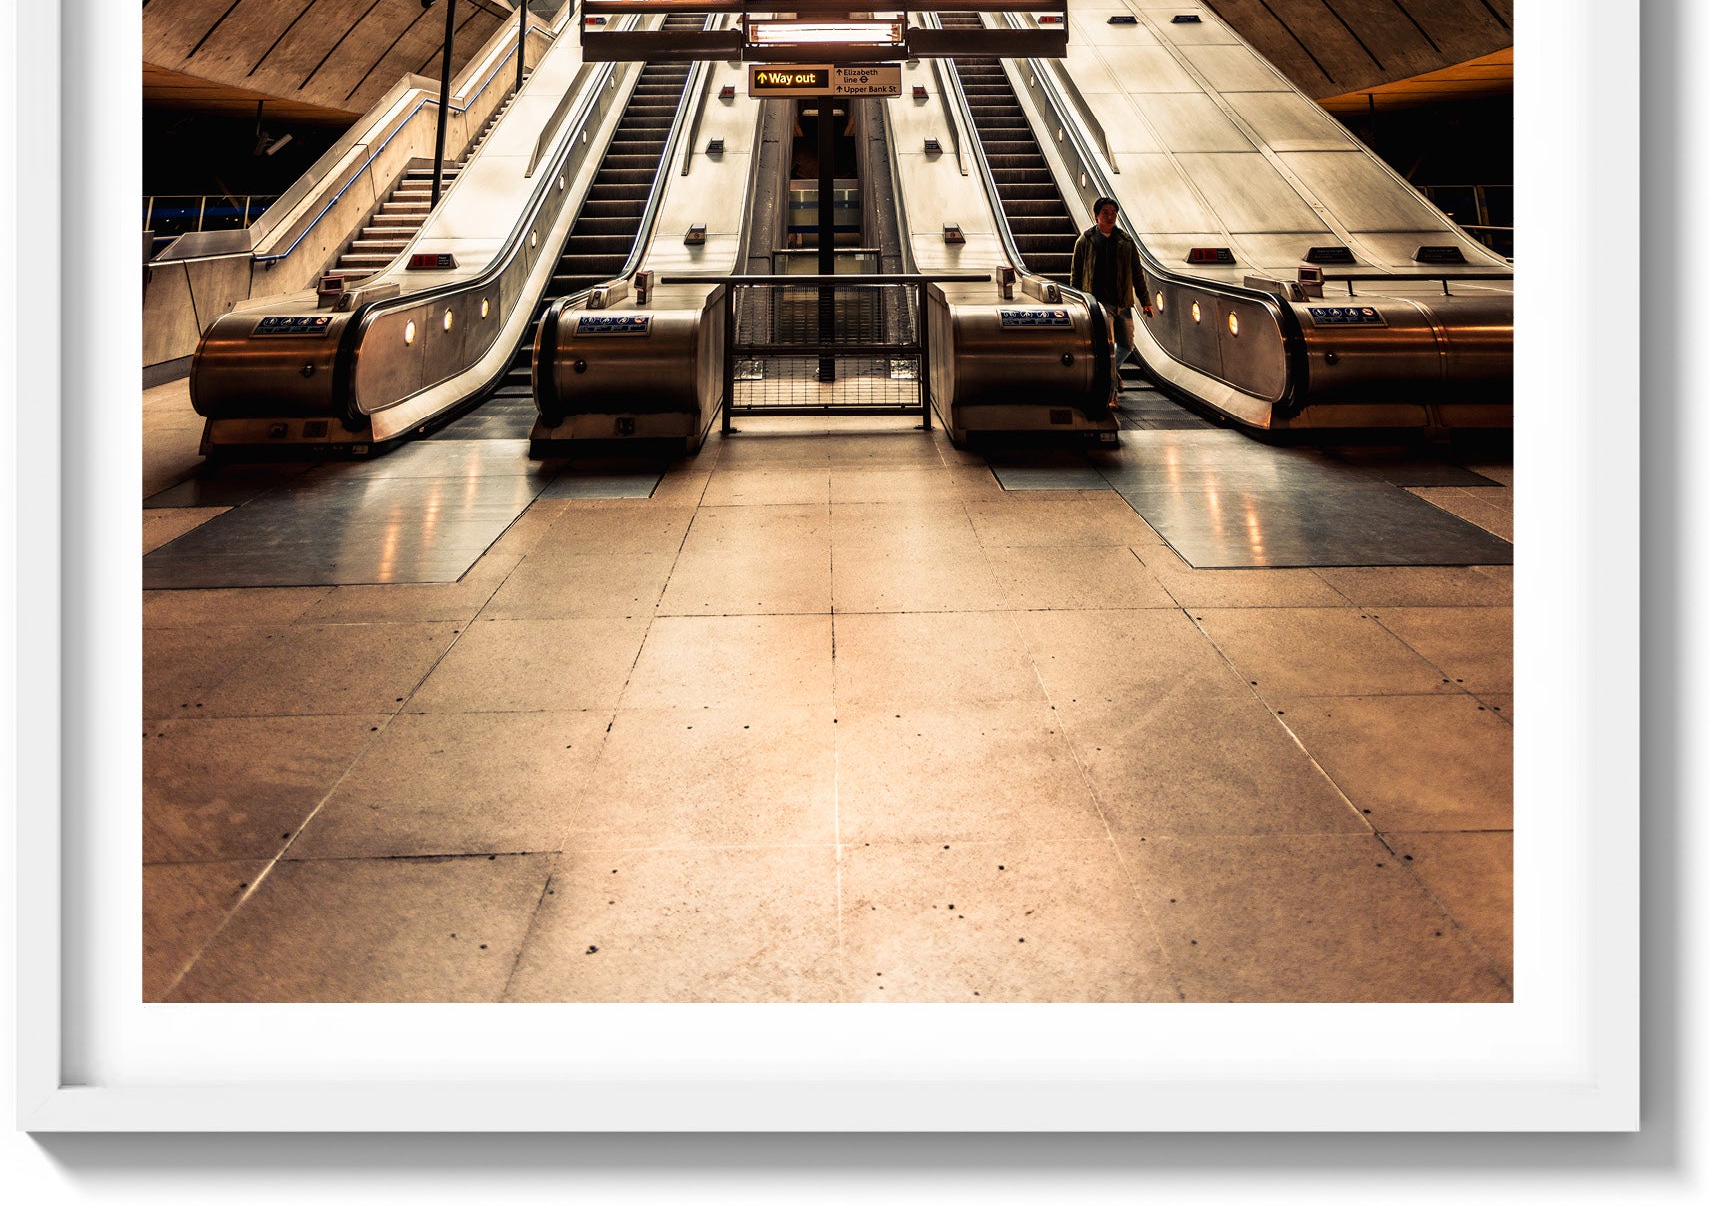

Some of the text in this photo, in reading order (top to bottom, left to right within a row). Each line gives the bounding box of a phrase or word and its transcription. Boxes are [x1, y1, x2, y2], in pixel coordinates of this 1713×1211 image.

[769, 73, 816, 85] Way out
[844, 86, 867, 94] Upper
